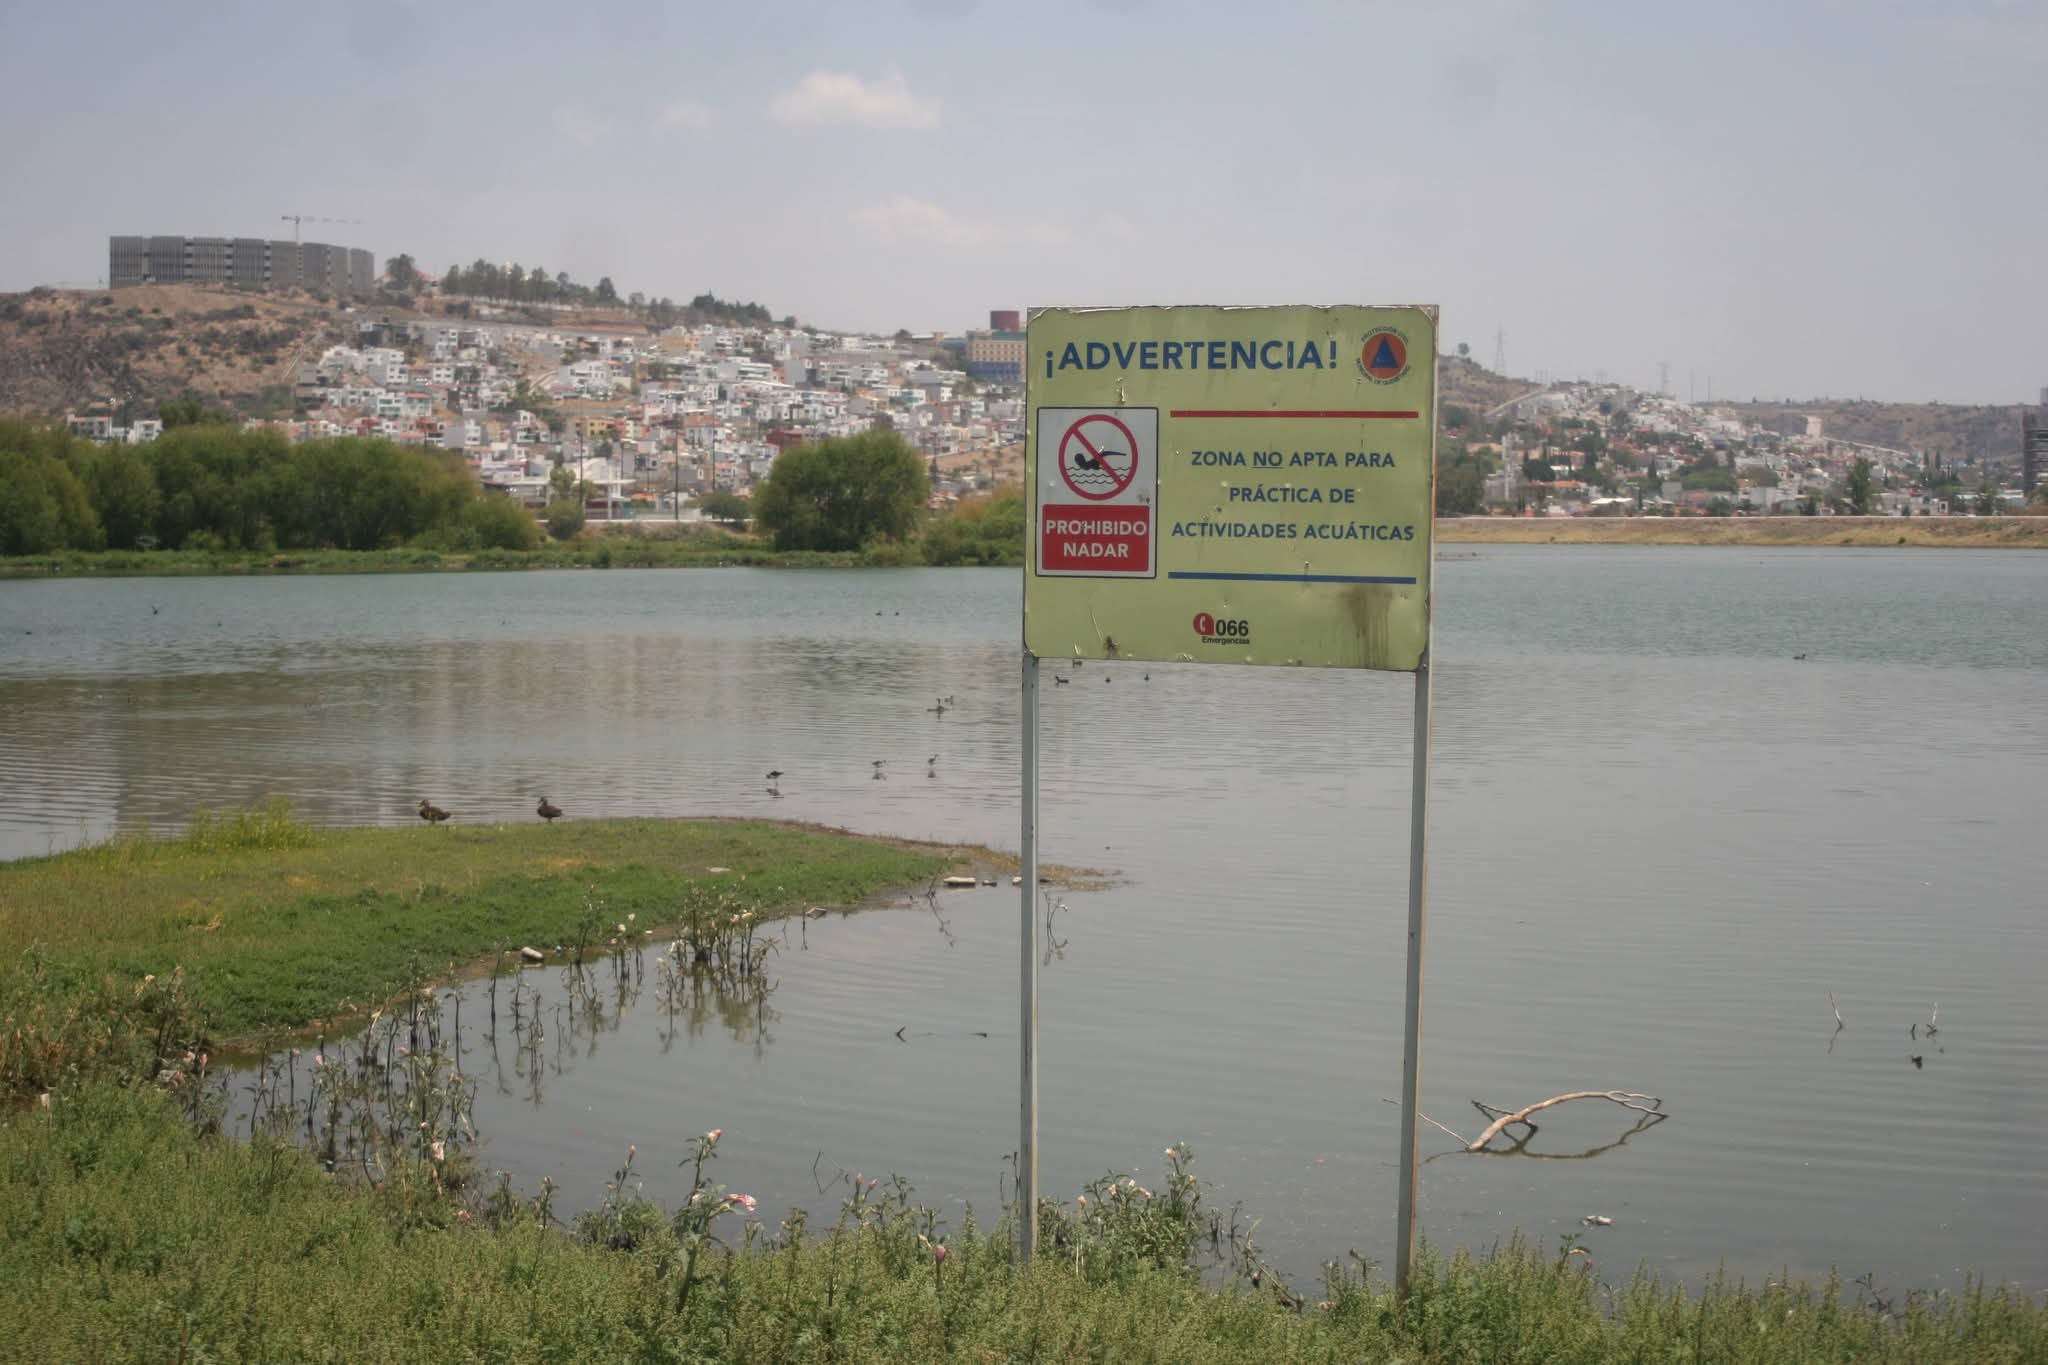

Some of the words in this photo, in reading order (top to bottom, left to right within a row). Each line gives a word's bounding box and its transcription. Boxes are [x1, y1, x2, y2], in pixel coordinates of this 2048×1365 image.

[1046, 340, 1337, 378] ¡ADVERTENCIA!
[1191, 451, 1247, 467] ZONA
[1252, 452, 1284, 467] NO
[1289, 453, 1338, 468] APTA
[1345, 453, 1395, 468] PARA
[1229, 486, 1323, 503] PRÁCTICA
[1330, 489, 1355, 503] DE
[1046, 519, 1148, 537] PROHIBIDO
[1171, 522, 1297, 539] ACTIVIDADES
[1303, 522, 1414, 541] ACUÁTICAS
[1063, 542, 1129, 558] NADAR
[1215, 619, 1249, 637] 066
[1202, 636, 1250, 646] Emergencias
